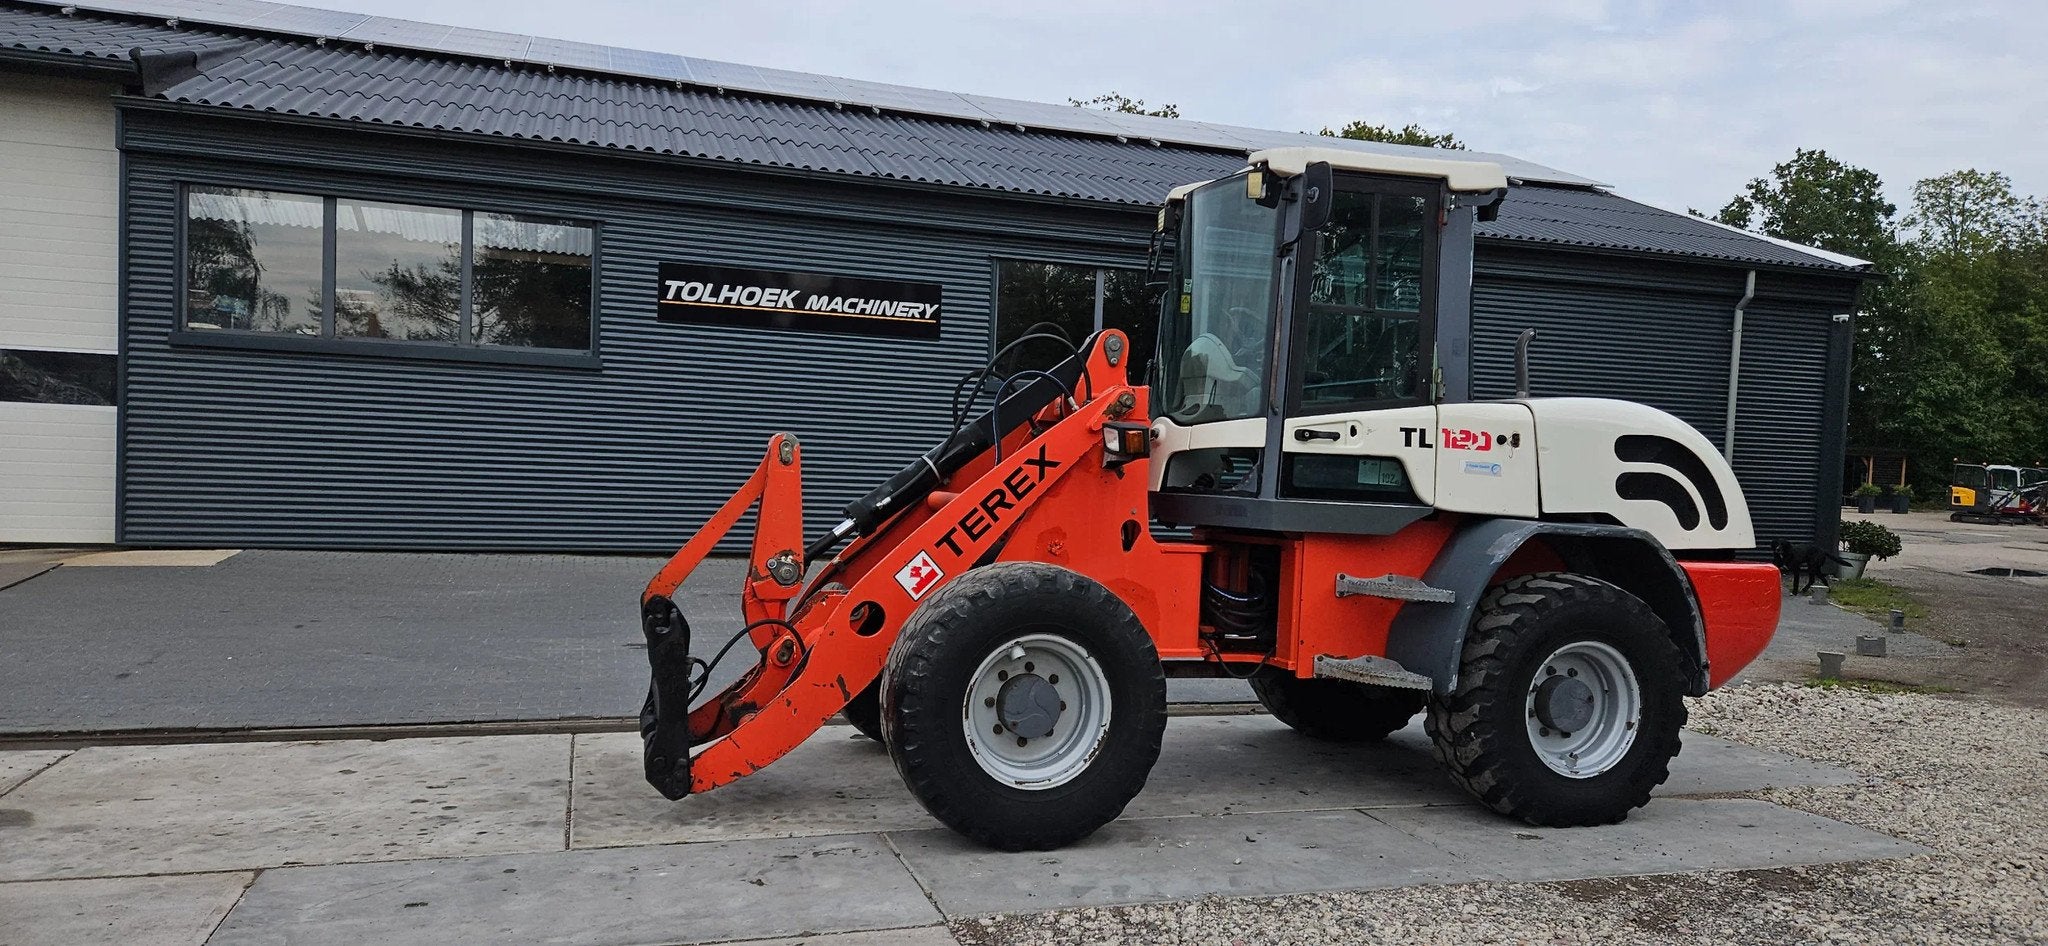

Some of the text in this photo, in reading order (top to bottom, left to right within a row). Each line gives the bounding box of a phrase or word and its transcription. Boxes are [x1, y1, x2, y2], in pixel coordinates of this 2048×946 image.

[664, 280, 939, 319] TOLHOEK MACHINERY
[1399, 427, 1492, 452] TL 120
[934, 443, 1062, 557] TEREX
